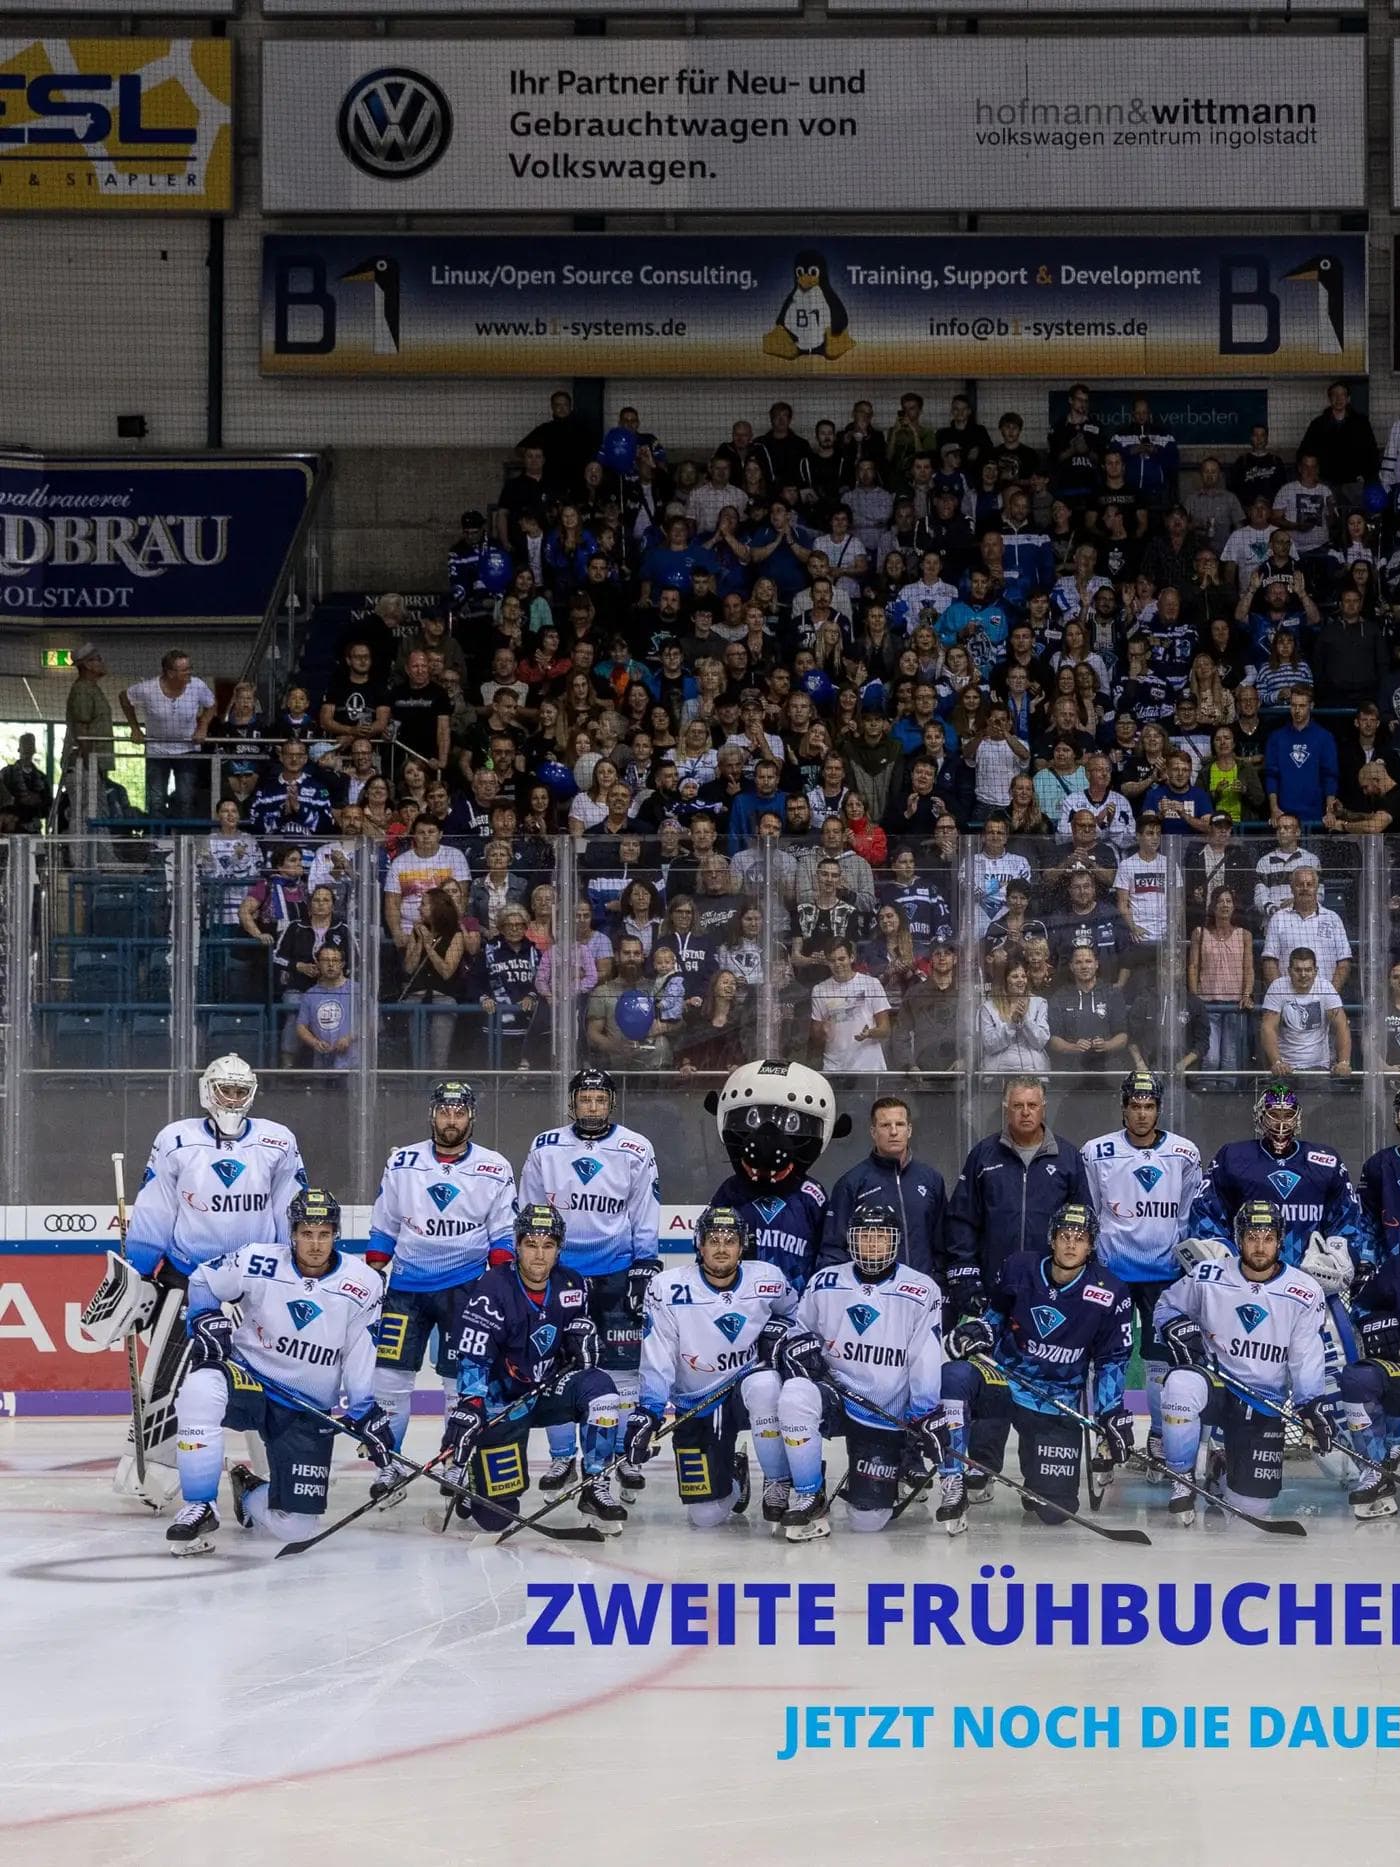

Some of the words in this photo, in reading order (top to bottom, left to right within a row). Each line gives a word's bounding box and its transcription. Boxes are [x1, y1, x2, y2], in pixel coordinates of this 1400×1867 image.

[509, 69, 549, 95] Ihr
[557, 68, 669, 96] Partner
[677, 67, 719, 95] für
[727, 69, 801, 95] Neu-
[808, 68, 865, 95] und
[510, 111, 788, 144] Gebrauchtwagen
[798, 115, 857, 137] von
[976, 128, 1104, 149] volkswagen
[1112, 129, 1200, 146] zentrum
[1210, 128, 1317, 149] ingolstadt
[67, 173, 197, 186] STAPLER
[508, 152, 716, 185] Volkswagen.
[431, 264, 556, 288] Linux/Open
[562, 265, 633, 286] Source
[639, 264, 758, 289] Consulting,
[847, 264, 940, 288] Training,
[944, 265, 1028, 288] Support
[1035, 266, 1053, 286] &
[1060, 264, 1201, 288] Development
[474, 317, 687, 341] www.b1-systems.de
[928, 317, 1148, 341] info@b1-systems.de
[536, 1133, 559, 1147] 80
[1096, 1143, 1115, 1158] 13
[394, 1151, 418, 1167] 37
[755, 1227, 808, 1257] SATURN
[248, 1254, 278, 1278] 53
[1199, 1264, 1225, 1281] 97
[814, 1272, 839, 1289] 20
[670, 1284, 692, 1305] 21
[458, 1326, 489, 1357] 88
[1026, 1339, 1085, 1365] SATURN
[843, 1341, 907, 1368] SATURN
[1037, 1444, 1079, 1459] HERRN
[856, 1458, 898, 1479] CINQUE
[1040, 1462, 1075, 1477] BRÄU
[491, 1480, 523, 1493] EDEKA
